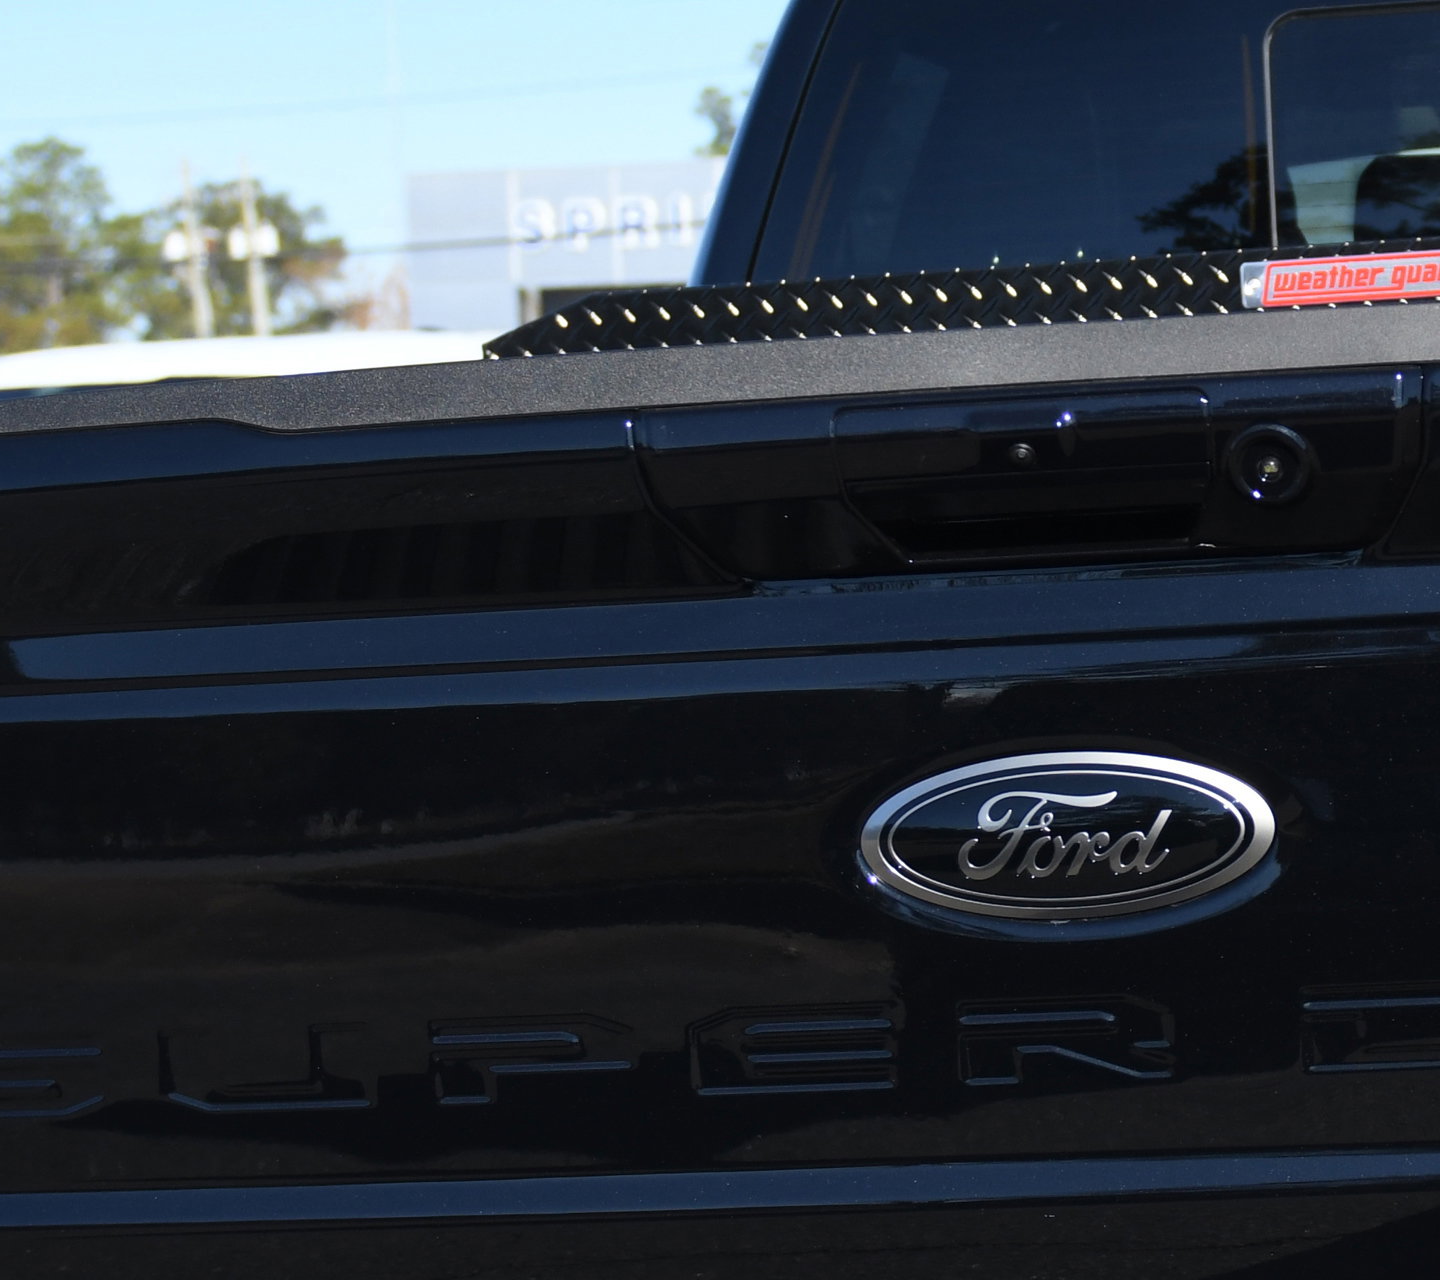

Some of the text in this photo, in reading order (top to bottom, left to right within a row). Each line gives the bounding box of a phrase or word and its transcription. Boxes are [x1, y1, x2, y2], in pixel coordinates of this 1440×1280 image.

[513, 194, 706, 251] SPRI
[1273, 265, 1385, 291] weather
[959, 790, 1170, 880] Ford
